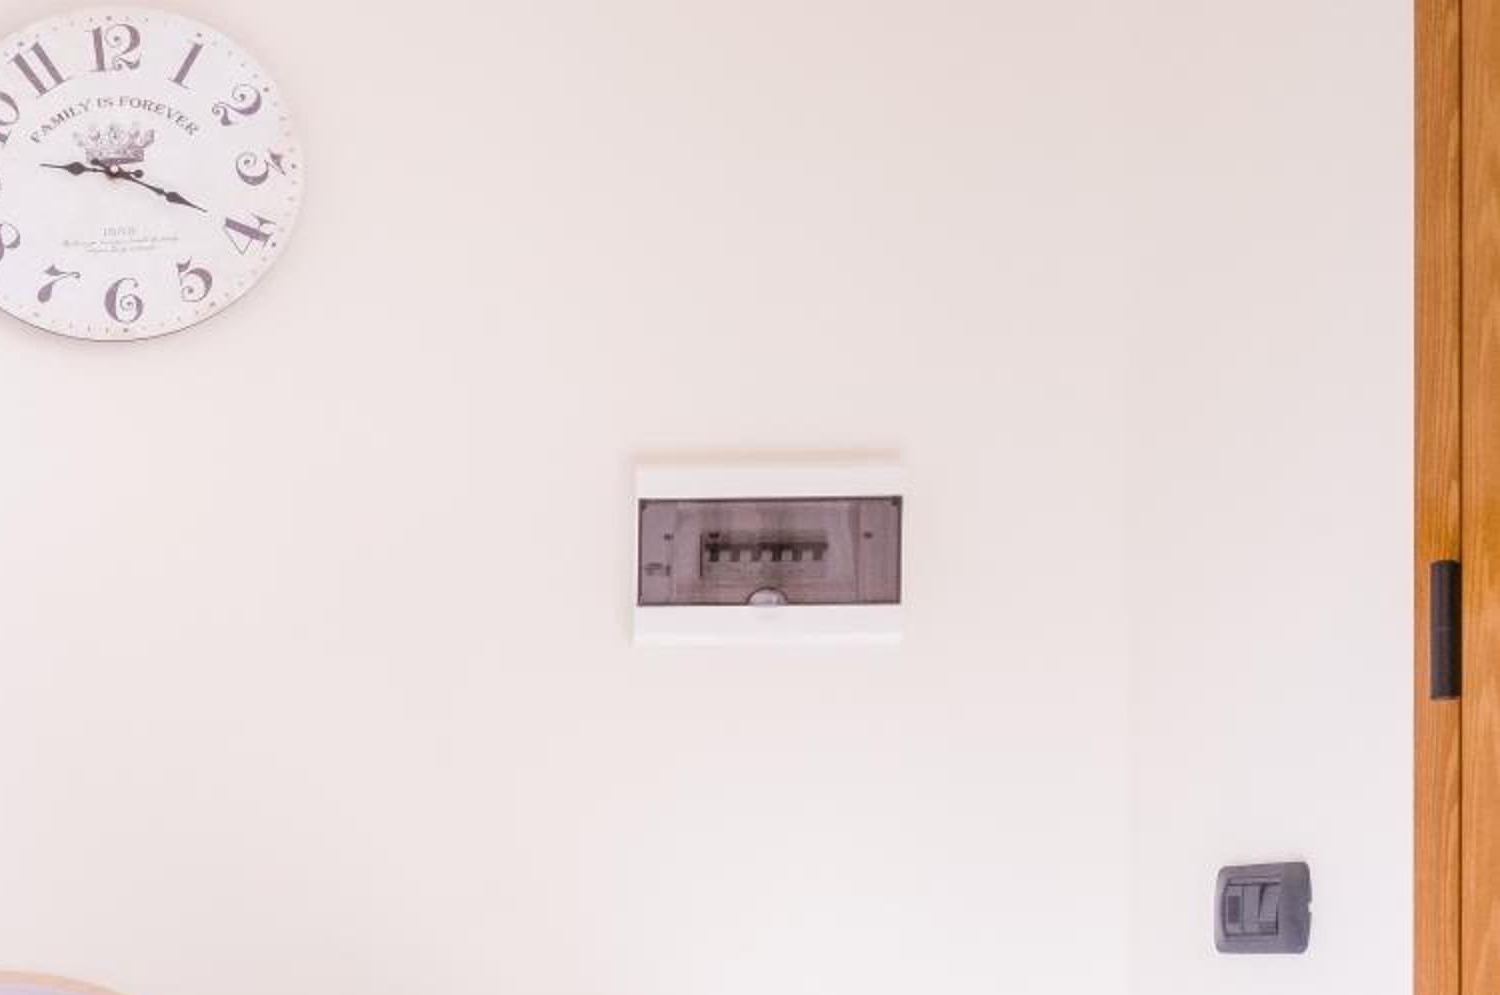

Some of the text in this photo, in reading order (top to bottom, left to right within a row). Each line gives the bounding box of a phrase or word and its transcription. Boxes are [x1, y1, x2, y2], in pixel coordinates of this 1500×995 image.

[8, 41, 72, 96] 11
[85, 23, 142, 73] 12
[168, 42, 205, 89] 1
[30, 95, 199, 143] FAMILY IS FOREVER
[211, 83, 263, 127] 2
[235, 148, 287, 187] 3
[224, 212, 278, 256] 4
[36, 263, 81, 304] 7
[104, 276, 144, 323] 6
[176, 256, 213, 303] 5
